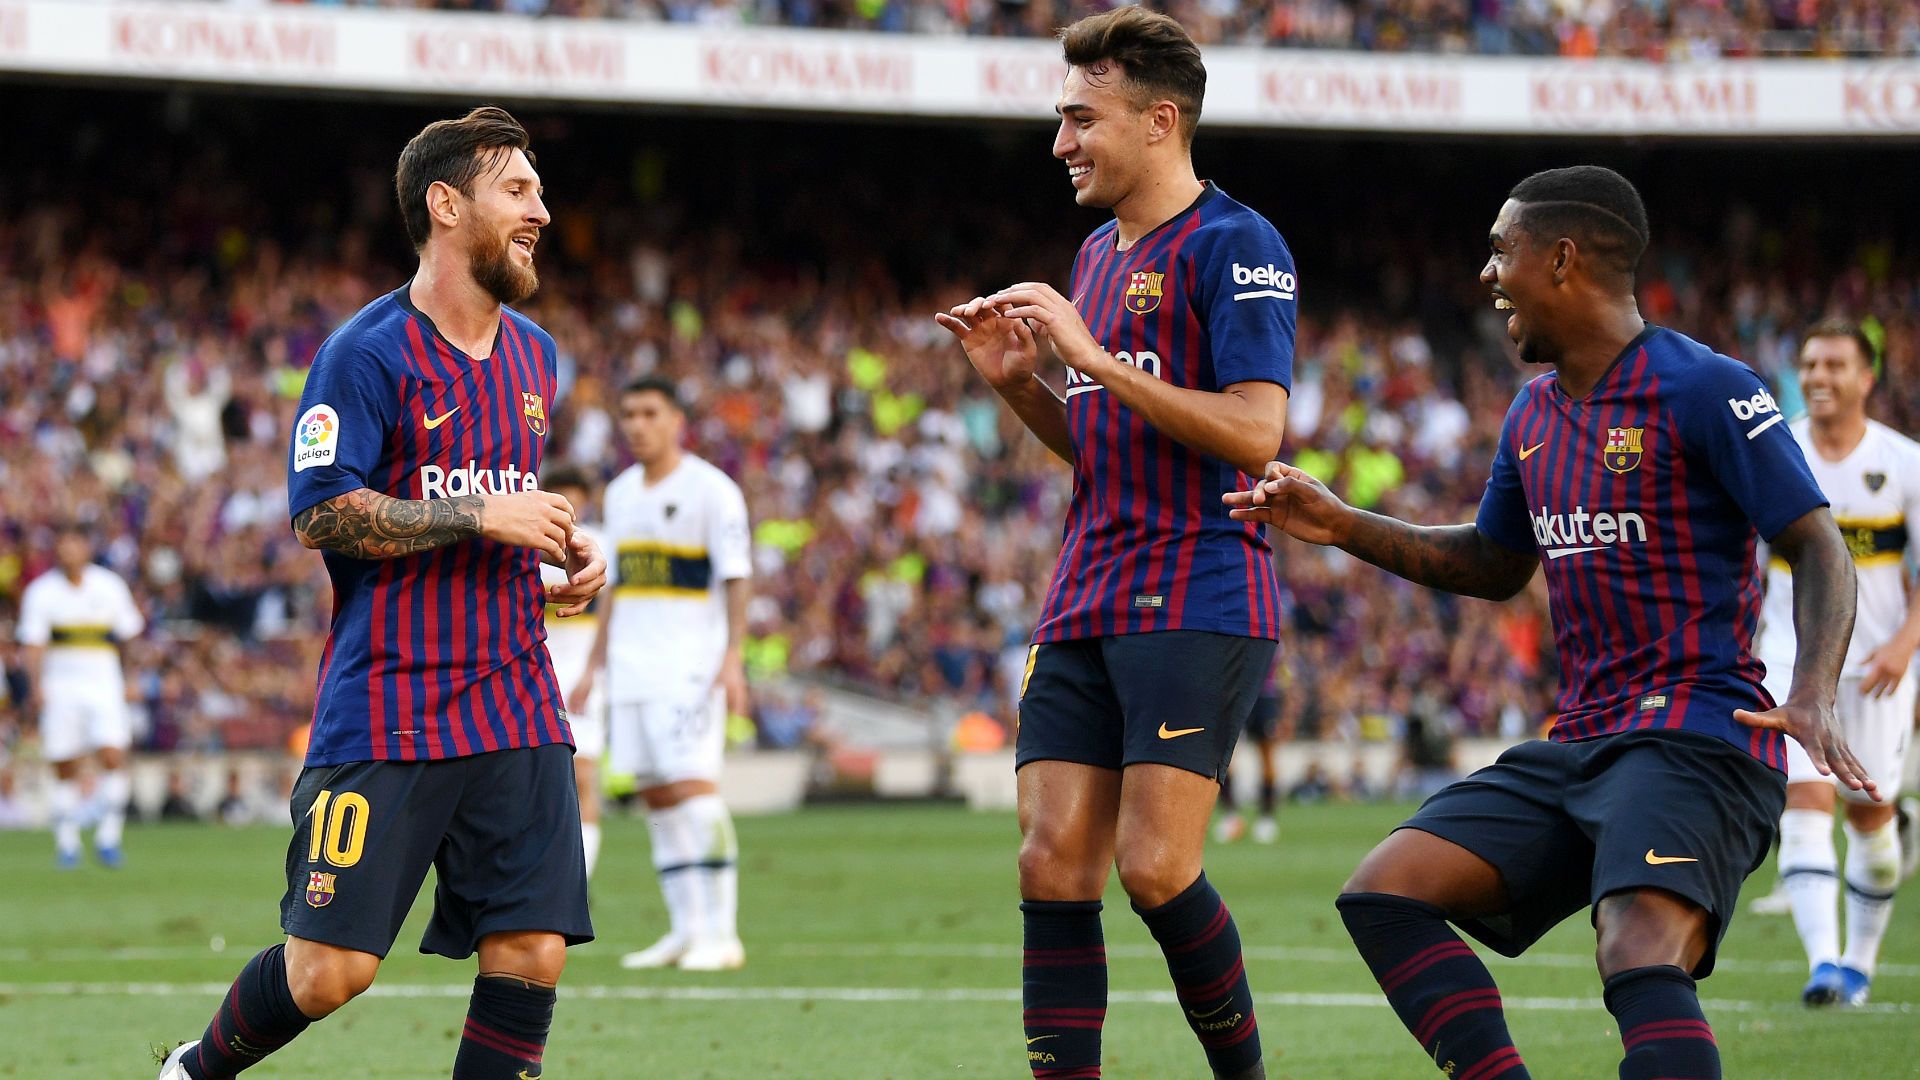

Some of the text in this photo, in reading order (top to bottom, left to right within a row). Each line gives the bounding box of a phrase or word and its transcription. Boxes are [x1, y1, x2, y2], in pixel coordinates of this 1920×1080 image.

[113, 14, 336, 66] KONAMI
[409, 29, 626, 82] KONAMI
[705, 39, 913, 95] KONAMI
[1262, 64, 1460, 110] KONAMI
[1532, 74, 1757, 120] KONAMI
[1232, 262, 1296, 293] beko
[297, 447, 331, 462] LaLiga
[305, 789, 370, 869] 10
